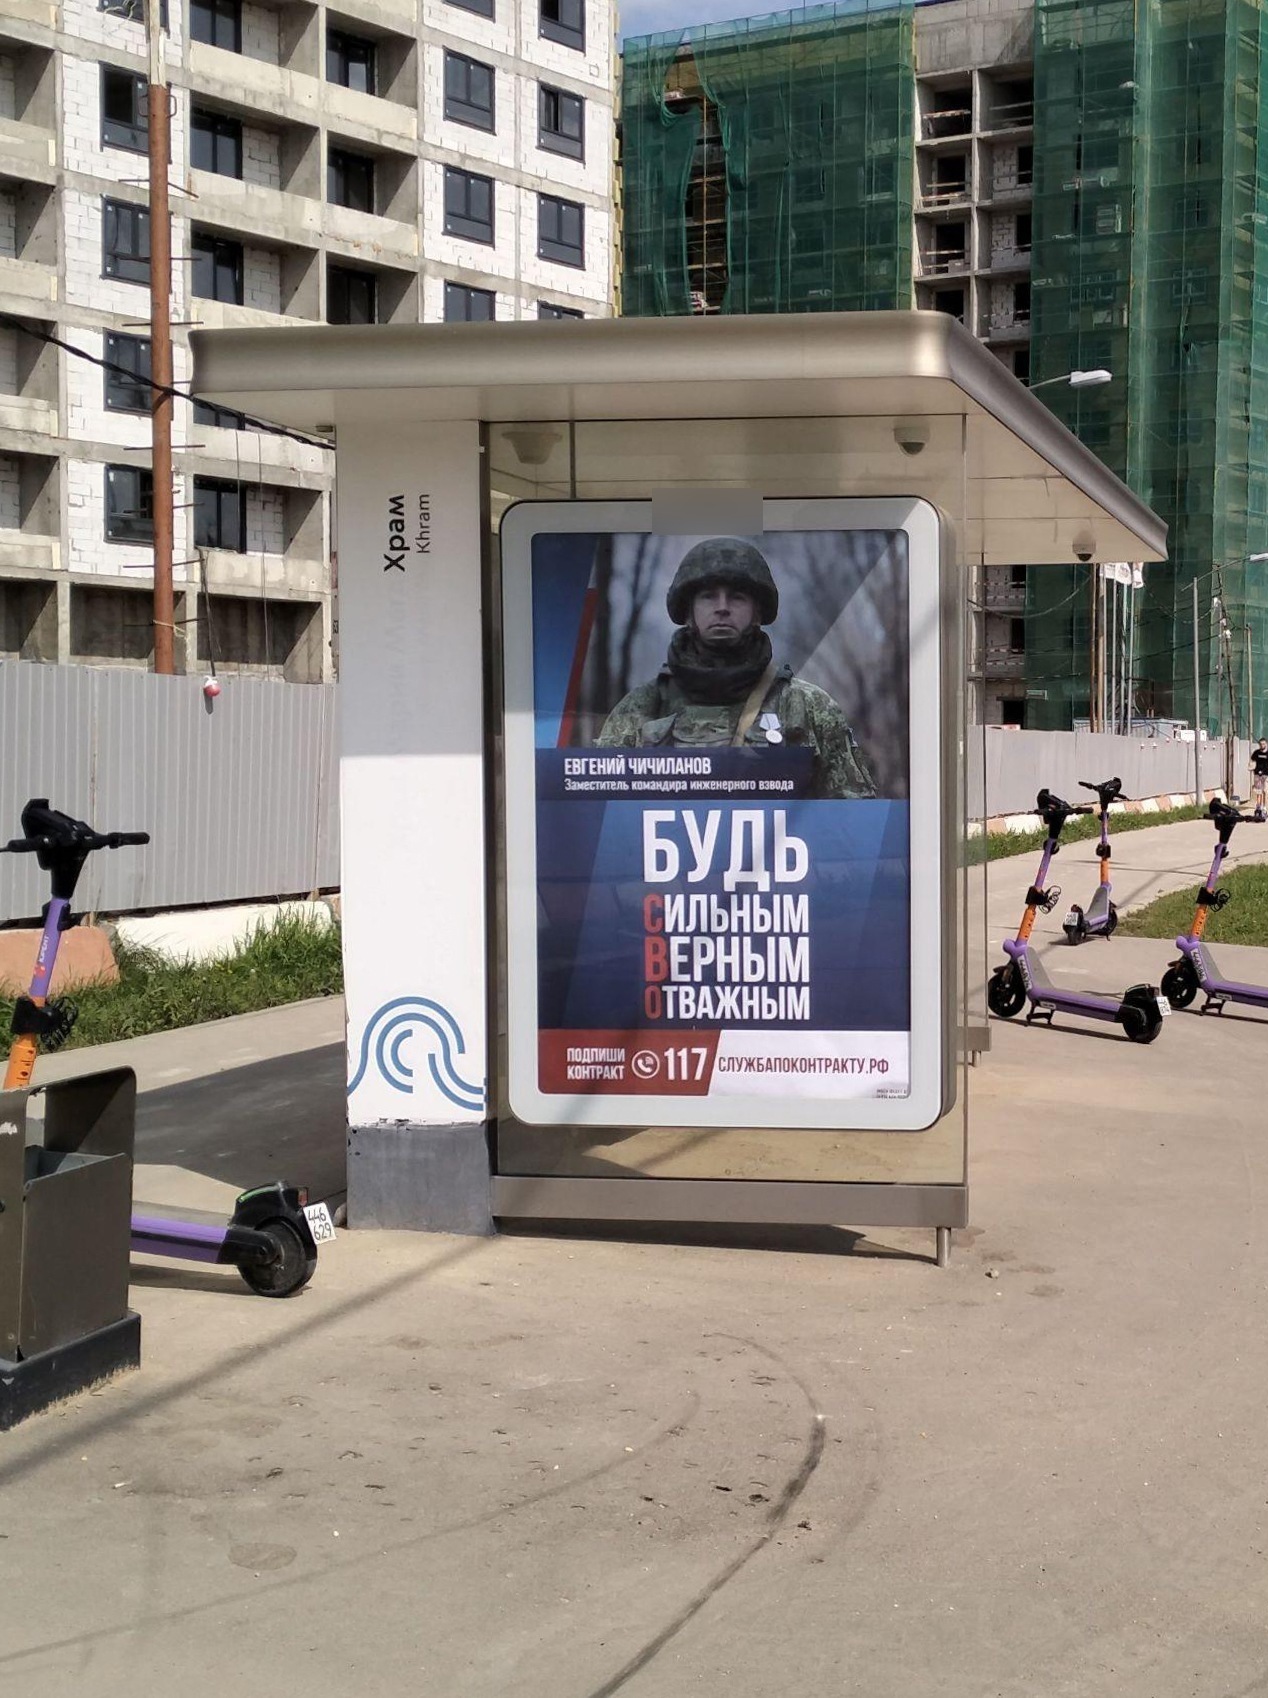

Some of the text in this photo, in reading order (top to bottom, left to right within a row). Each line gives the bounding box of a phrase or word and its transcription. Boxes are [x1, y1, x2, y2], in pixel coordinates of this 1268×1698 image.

[383, 494, 411, 573] Храм
[414, 493, 431, 554] Khram
[564, 754, 712, 775] ЕВГЕНИЙ ЧИЧИЛАНОВ
[564, 778, 794, 793] Заместитель командира инженерного взвода
[643, 810, 809, 892] БУДЬ
[643, 893, 809, 934] СИЛЬНЫМ
[644, 936, 810, 983] ВЕРНЫМ
[644, 985, 810, 1021] ОТВАЖНЫМ
[566, 1047, 625, 1063] ПОДПИШИ
[663, 1047, 708, 1081] 117
[718, 1056, 890, 1075] СЛУЖБАПОКОНТРАКТУ.РФ
[566, 1064, 625, 1080] КОНТРАКТ
[308, 1207, 327, 1223] 446
[313, 1222, 332, 1240] 629
